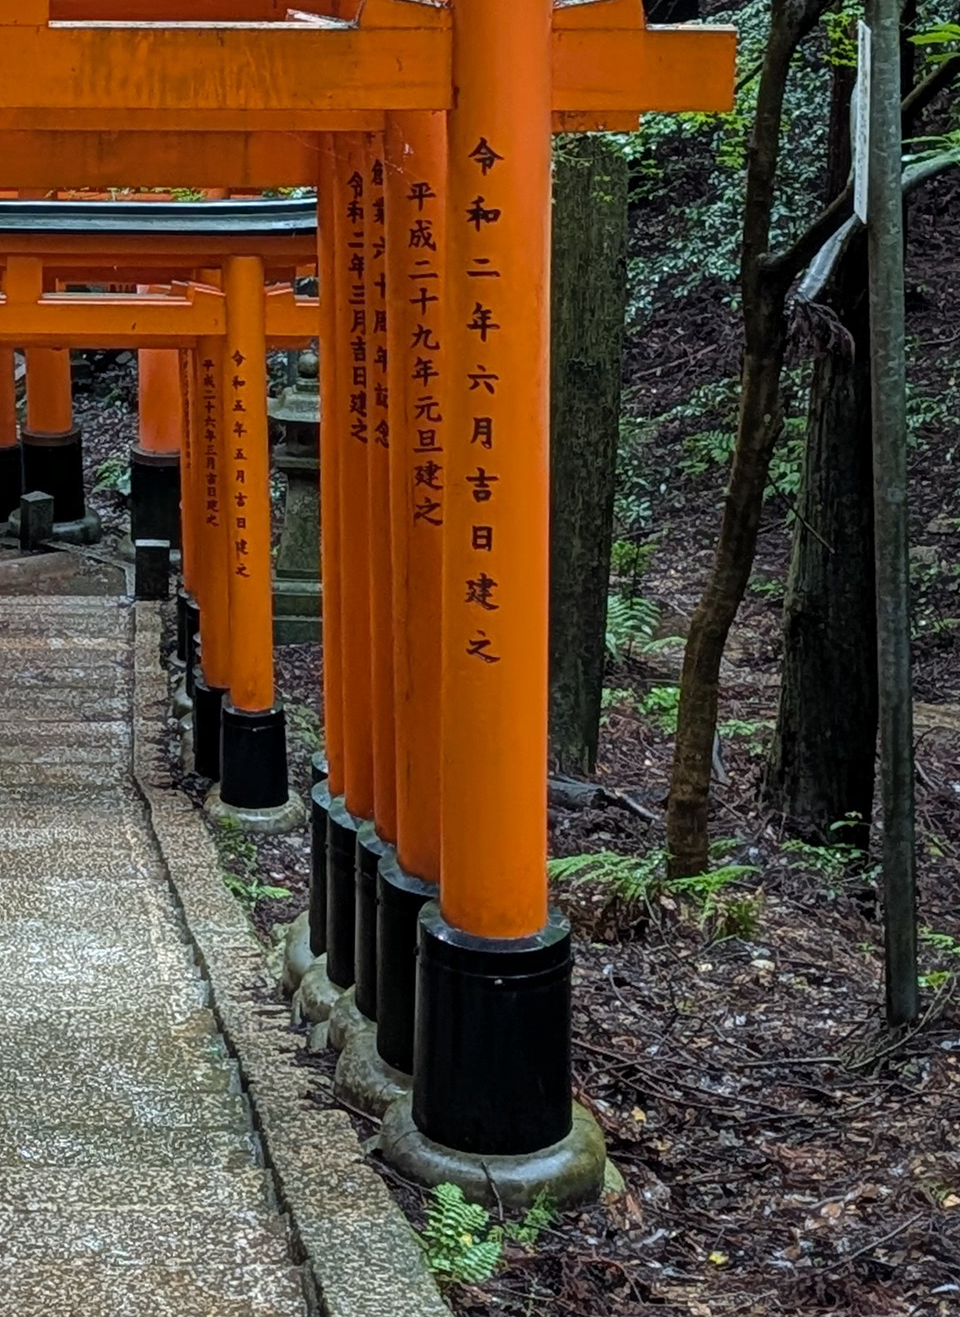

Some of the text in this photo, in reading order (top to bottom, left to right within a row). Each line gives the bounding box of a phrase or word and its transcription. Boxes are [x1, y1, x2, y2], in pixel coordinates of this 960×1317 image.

[347, 171, 368, 444] 令和二年三月吉日建之
[406, 182, 444, 526] 平成二十九年元旦建之
[464, 137, 505, 664] 令和二年六月吉日建之
[231, 349, 250, 578] 令和五年五月吉日建之
